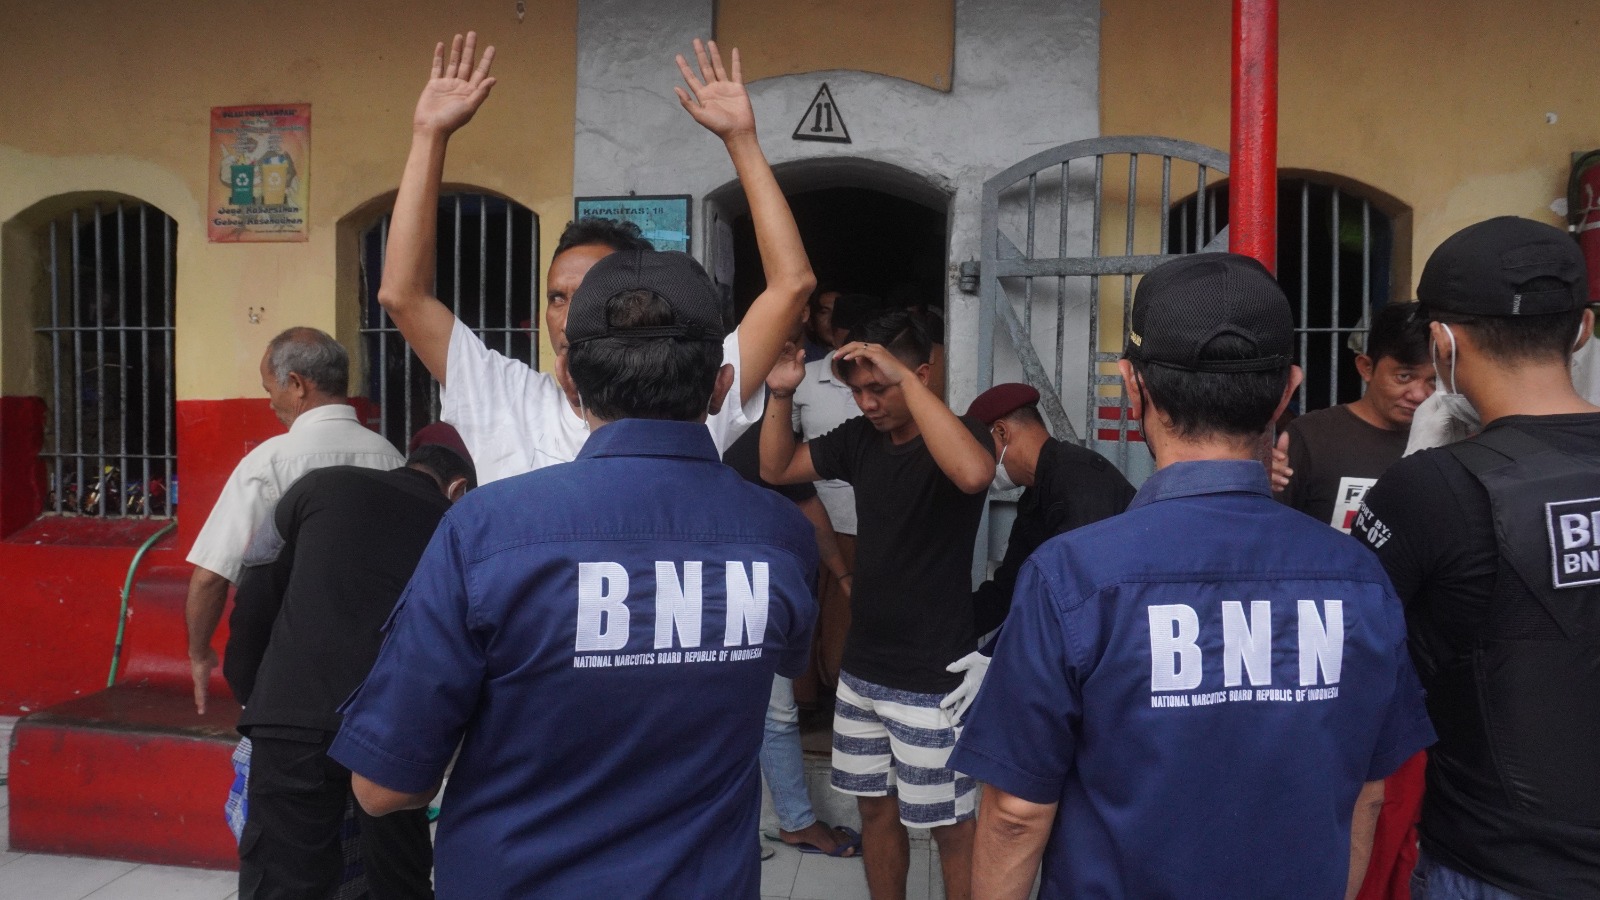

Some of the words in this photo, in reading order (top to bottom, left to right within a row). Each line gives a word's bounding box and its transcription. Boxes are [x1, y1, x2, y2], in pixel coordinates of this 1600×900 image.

[810, 102, 834, 133] 11
[575, 561, 769, 651] BNN
[573, 656, 612, 668] NATIONAL
[614, 653, 655, 667] NARCOTICS
[657, 652, 682, 664] BOARD
[684, 650, 717, 663] REPUBLIC
[718, 650, 728, 662] OF
[729, 647, 763, 662] INDONESIA
[1148, 600, 1344, 692] BNN
[1151, 695, 1190, 708] NATIONAL
[1191, 691, 1227, 707] NARCOTICS
[1229, 690, 1253, 702] BOARD
[1256, 689, 1292, 702] REPUBLIC
[1295, 689, 1306, 702] OF
